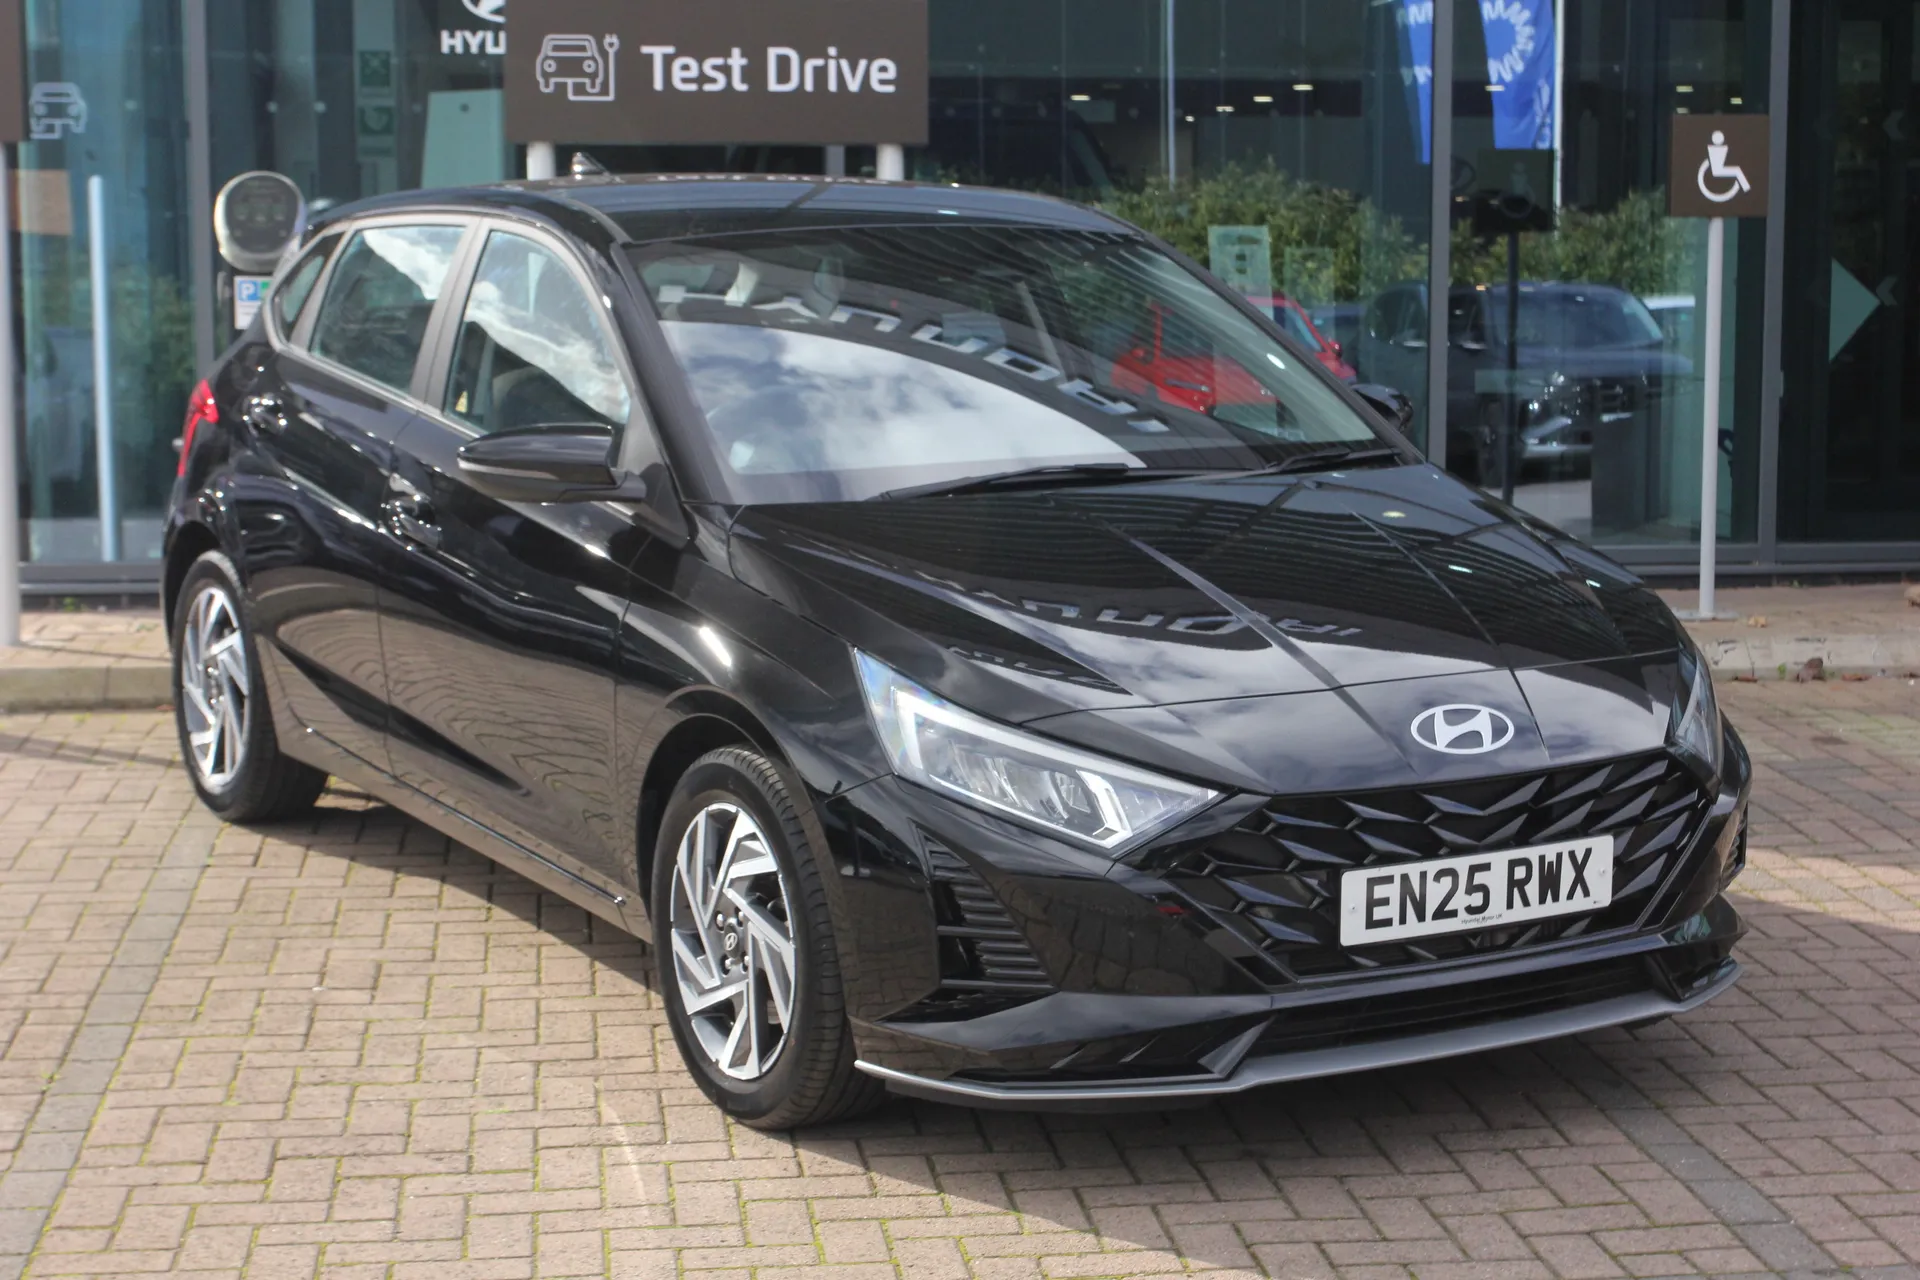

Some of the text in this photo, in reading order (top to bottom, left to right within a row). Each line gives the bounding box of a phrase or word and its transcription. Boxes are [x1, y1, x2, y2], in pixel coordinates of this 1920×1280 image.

[640, 46, 897, 93] Test Drive
[241, 282, 255, 299] P
[1365, 847, 1593, 929] EN25 RWX
